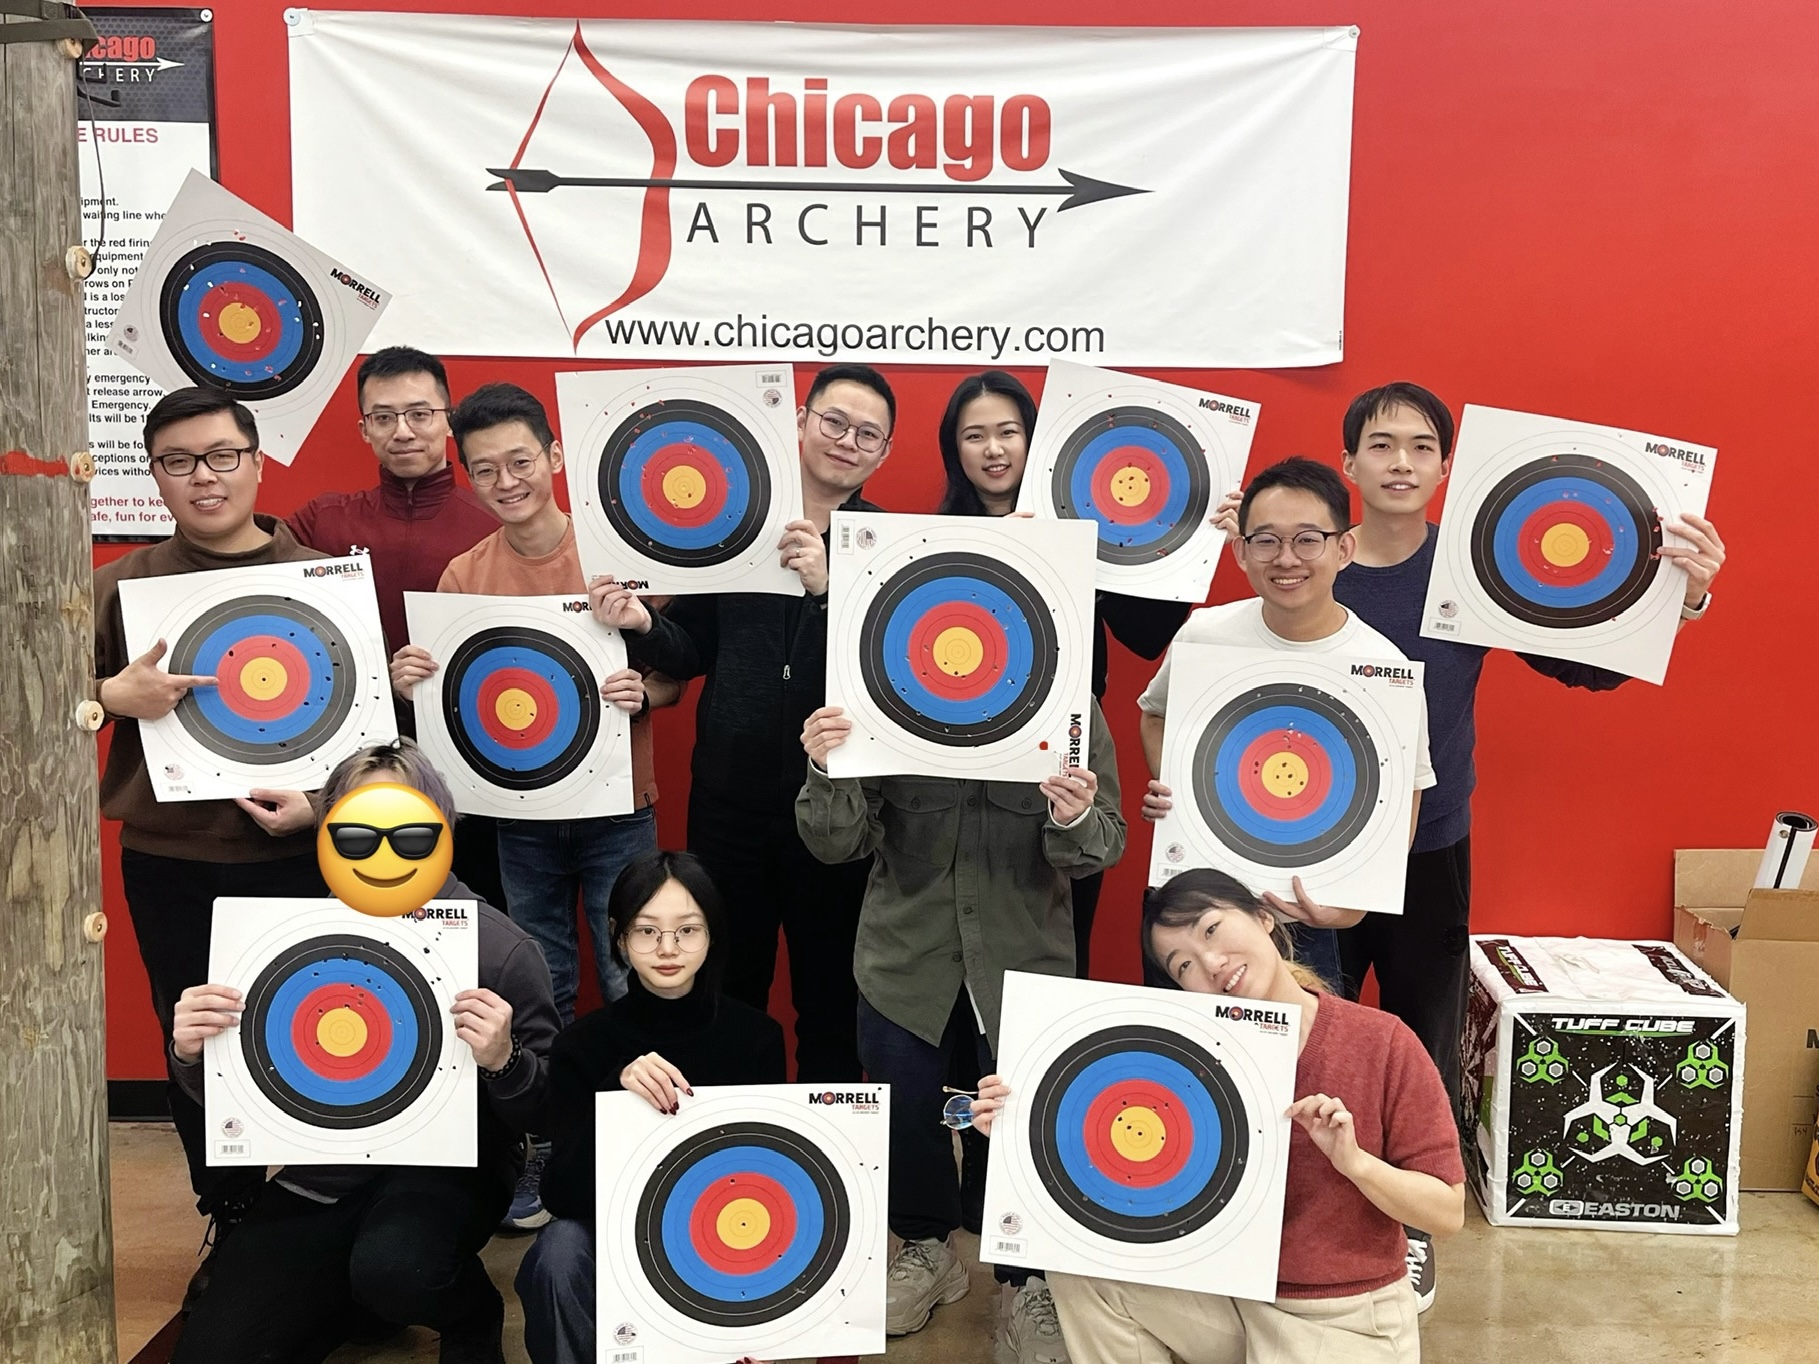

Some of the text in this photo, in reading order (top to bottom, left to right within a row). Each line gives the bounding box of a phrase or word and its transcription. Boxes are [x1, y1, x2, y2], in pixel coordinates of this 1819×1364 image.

[685, 74, 1051, 182] Chicago
[95, 127, 159, 143] RULES
[123, 210, 142, 220] line
[145, 211, 167, 220] whe
[686, 202, 1048, 248] ARCHERY
[90, 238, 106, 247] the
[109, 238, 126, 247] red
[129, 238, 150, 247] firin
[90, 252, 143, 263] quipment
[97, 266, 119, 277] only
[85, 280, 109, 288] rows
[112, 280, 125, 288] on
[330, 268, 381, 304] MORRELL
[90, 292, 99, 301] is
[111, 292, 125, 301] los
[84, 307, 118, 315] tructor
[95, 320, 114, 328] less
[87, 333, 108, 341] lkin
[605, 314, 1105, 359] www.chicagoarchery.com
[95, 374, 151, 385] emergency
[93, 387, 130, 396] release
[92, 400, 151, 411] Emergency.
[1199, 398, 1250, 418] MORRELL
[89, 413, 102, 422] lts
[104, 413, 121, 422] will
[124, 414, 137, 423] be
[98, 440, 115, 448] will
[118, 440, 130, 449] be
[133, 441, 144, 449] fo
[92, 454, 136, 464] ceptions
[1645, 442, 1705, 465] MORRELL
[122, 467, 151, 475] witho
[91, 497, 164, 508] gether to ke
[91, 512, 111, 522] afe,
[115, 512, 135, 521] fun
[139, 512, 156, 521] for
[303, 563, 363, 578] MORRELL
[1351, 664, 1414, 679] MORRELL
[1215, 1005, 1289, 1025] MORRELL
[1551, 1018, 1696, 1032] TUFF CUBE
[809, 1091, 879, 1105] MORRELL
[1584, 1202, 1680, 1218] EASTON
